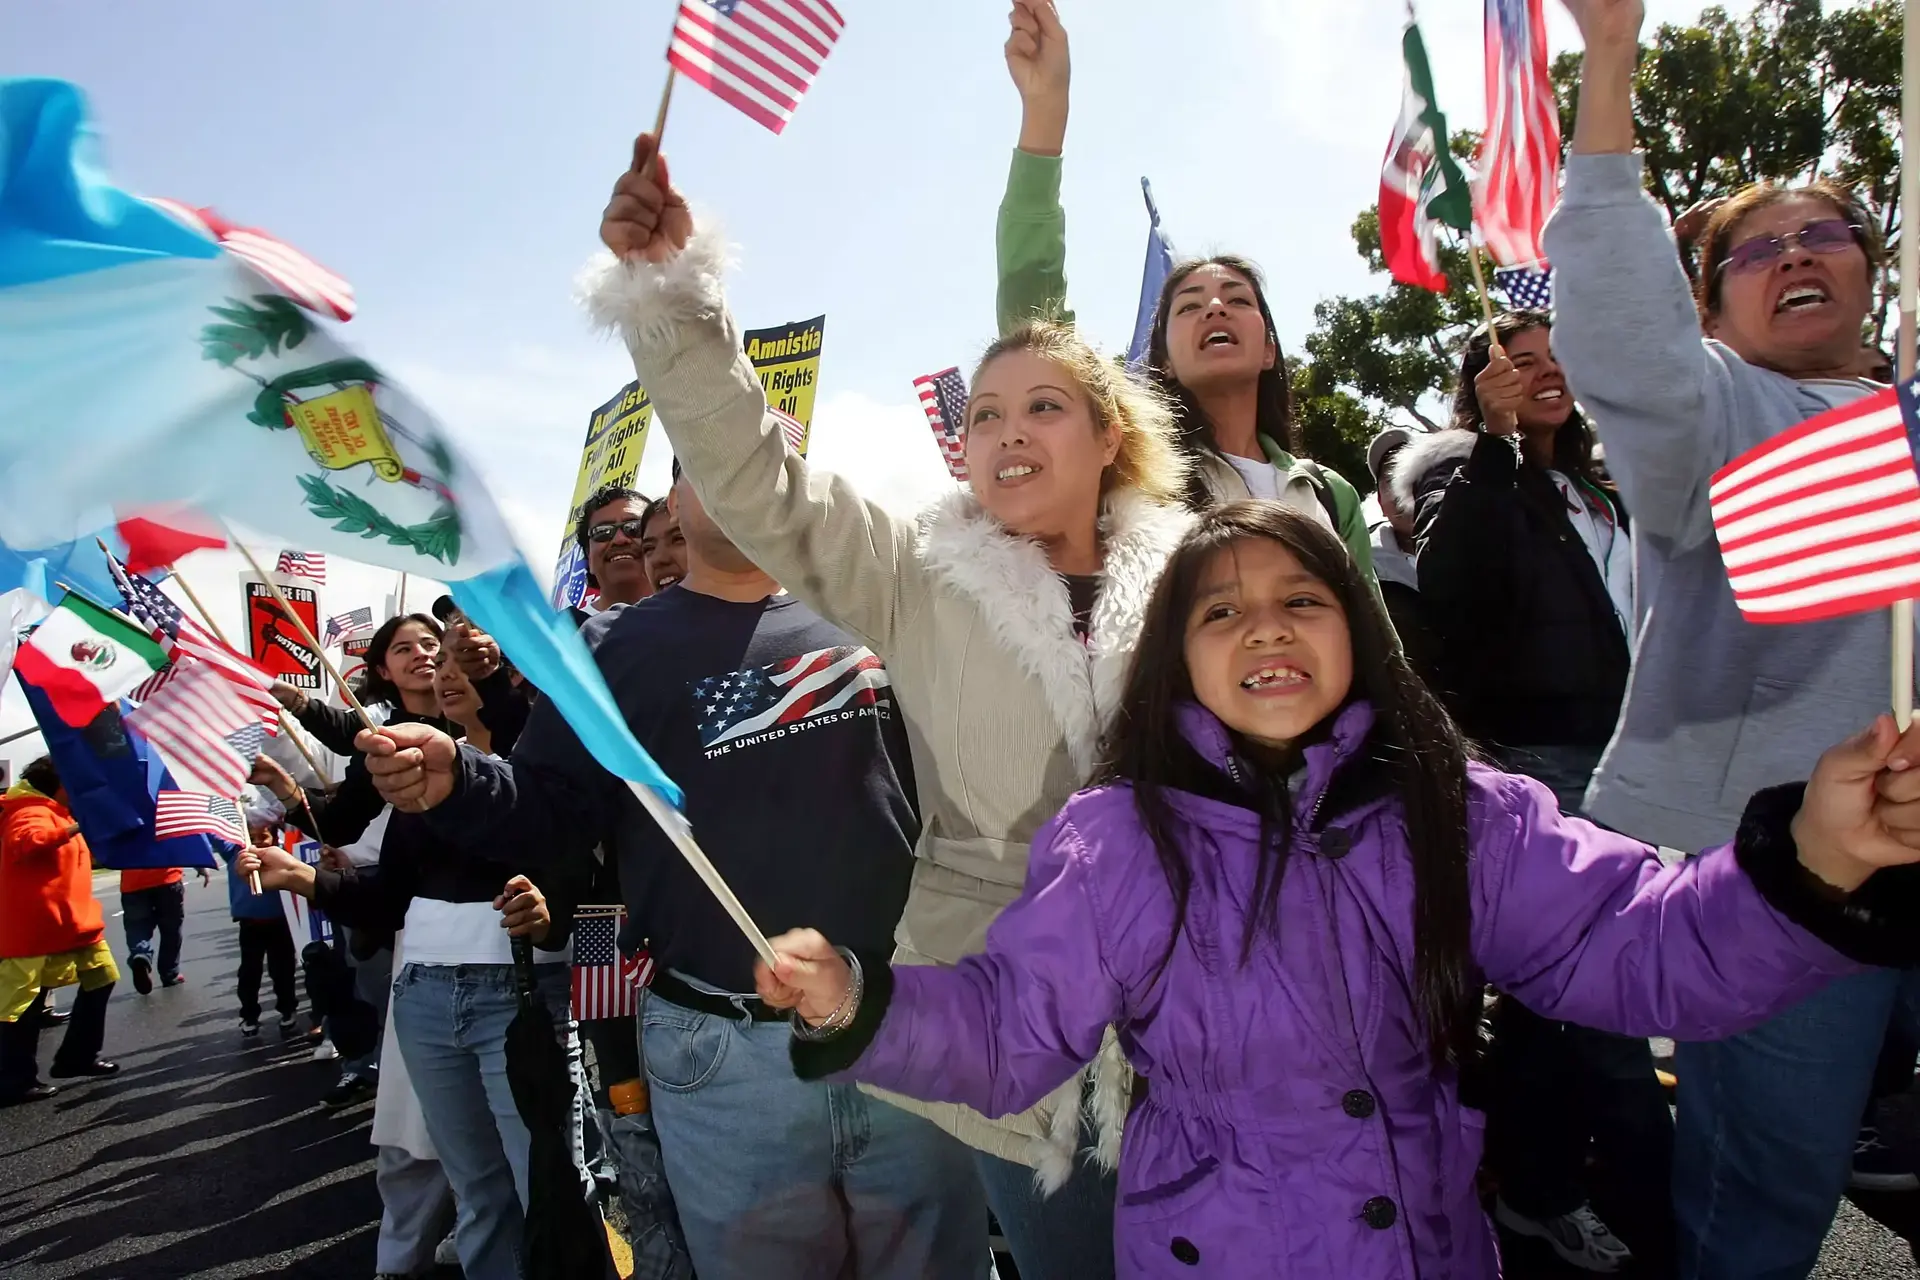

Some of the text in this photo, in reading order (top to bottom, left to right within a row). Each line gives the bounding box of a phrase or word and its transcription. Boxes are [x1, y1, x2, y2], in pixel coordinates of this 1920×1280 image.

[747, 326, 822, 362] Amnistía
[771, 367, 814, 395] Rights
[589, 385, 648, 439] Amnist
[778, 396, 798, 417] All
[585, 414, 647, 470] Full Rights
[588, 464, 603, 489] for
[604, 447, 627, 474] All
[295, 588, 313, 603] FOR
[347, 638, 373, 650] JUSTIC
[704, 707, 891, 760] THE UNITED STATES OF AMEICA
